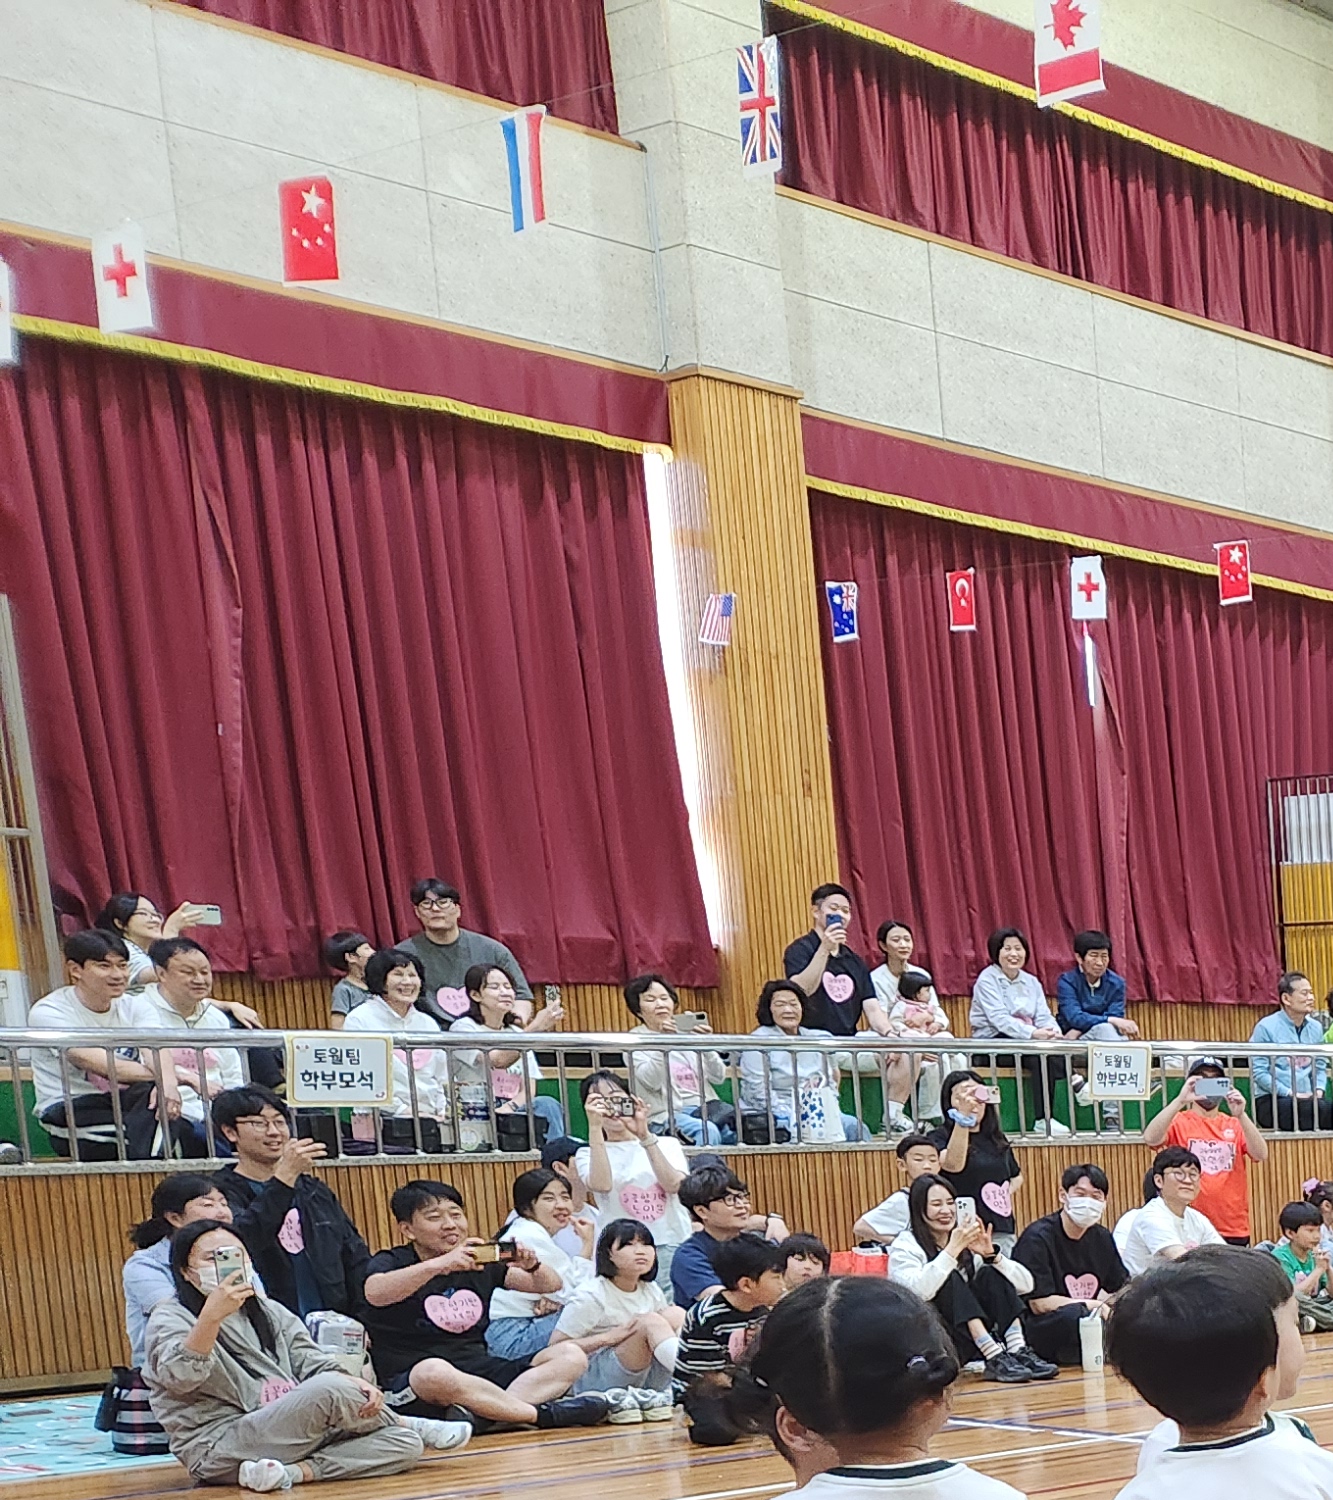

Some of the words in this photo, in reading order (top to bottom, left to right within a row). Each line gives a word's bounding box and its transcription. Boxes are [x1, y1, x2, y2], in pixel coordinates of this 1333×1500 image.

[314, 1047, 360, 1066] 토월팀
[1104, 1054, 1132, 1069] 토월팀
[300, 1069, 373, 1090] 학부모석
[1096, 1070, 1139, 1088] 학부모석
